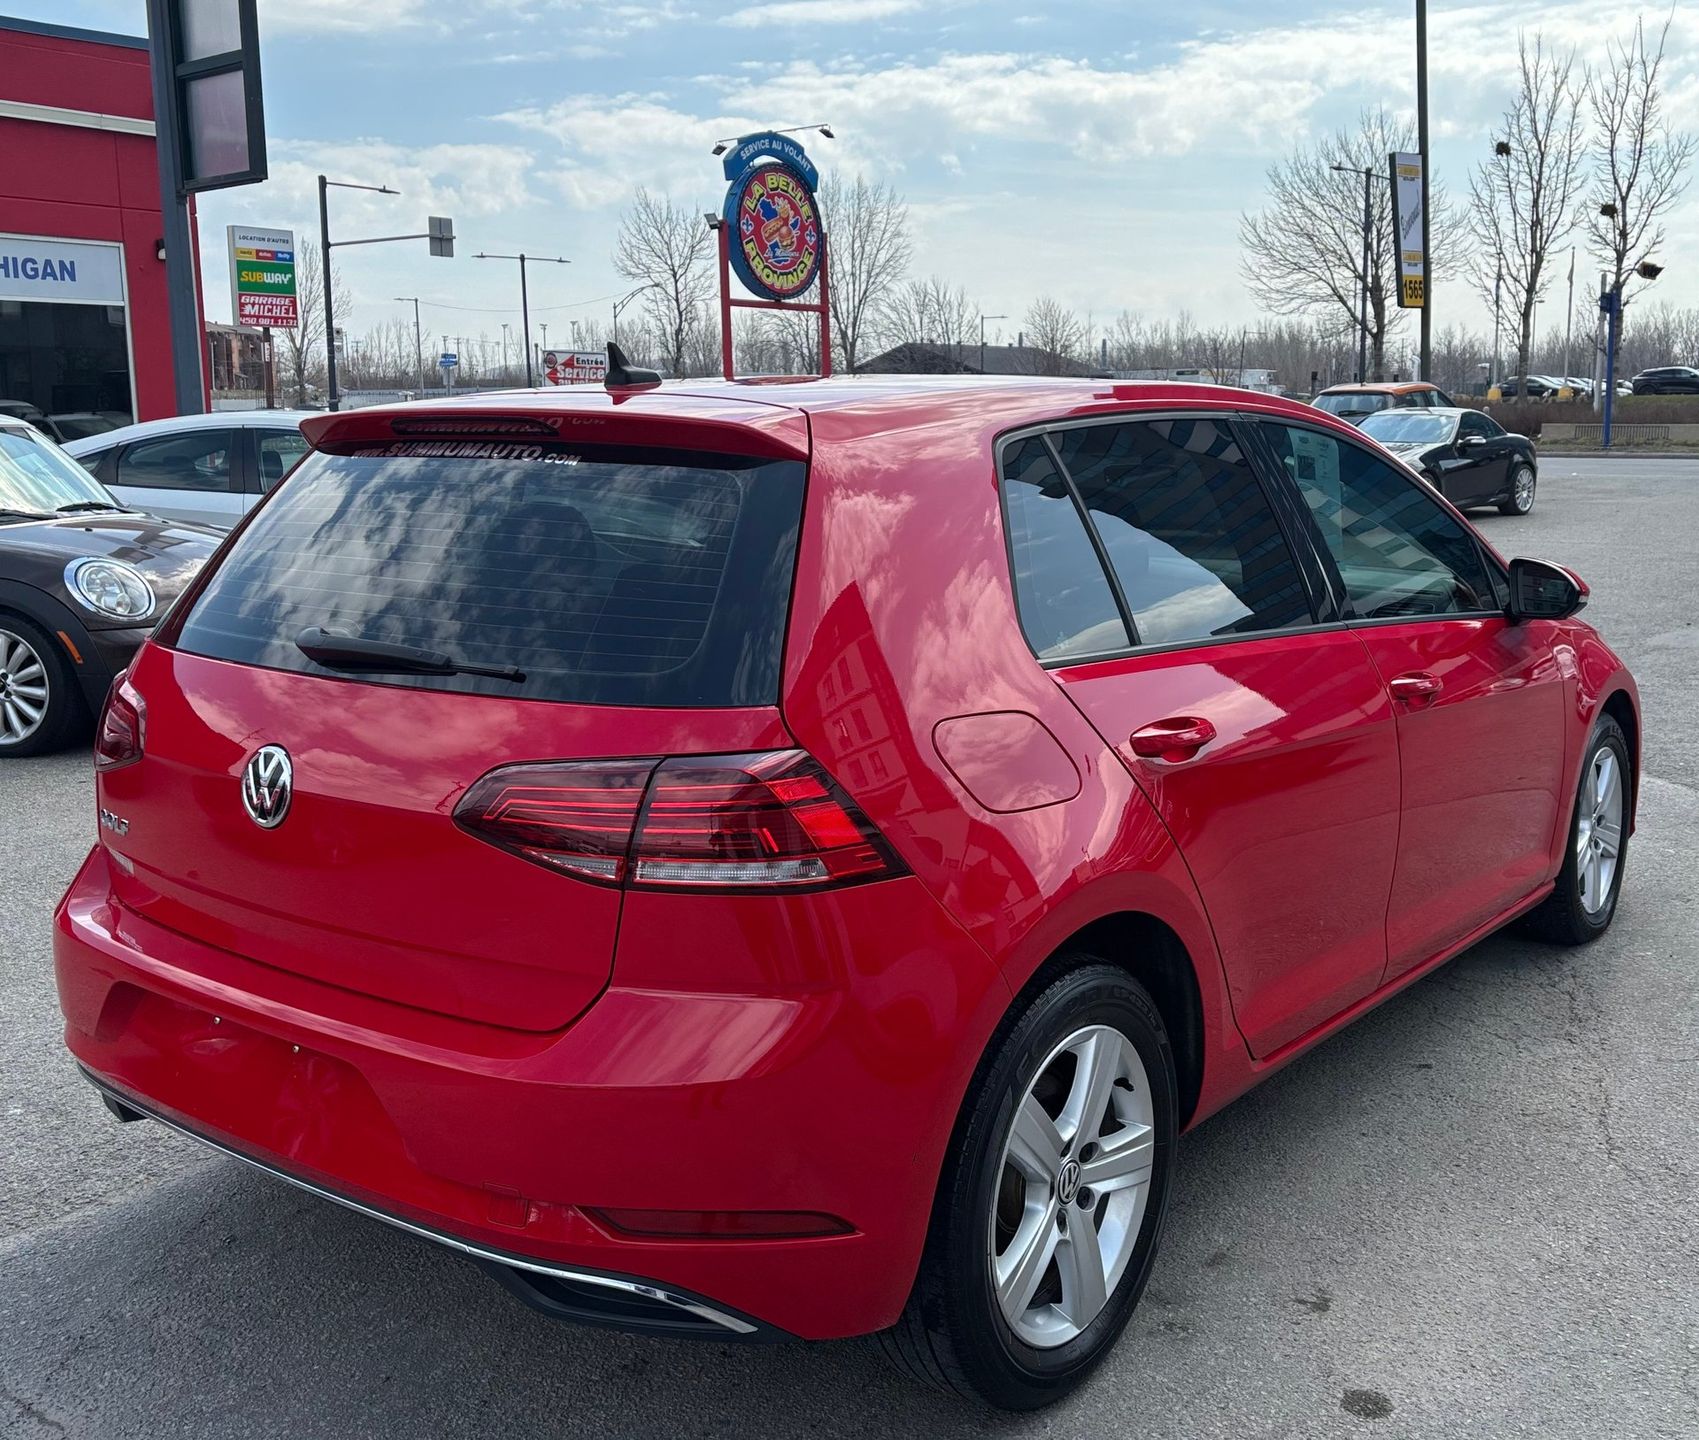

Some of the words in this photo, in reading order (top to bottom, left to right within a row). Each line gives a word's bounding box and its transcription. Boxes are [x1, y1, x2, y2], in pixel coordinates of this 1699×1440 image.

[740, 139, 770, 160] SERVICE
[772, 140, 782, 150] AU
[784, 144, 812, 171] VOLANT
[745, 181, 766, 213] LA
[765, 172, 813, 224] BELLE
[238, 234, 266, 242] LOCATION
[743, 236, 814, 290] PROVINCE
[240, 271, 292, 284] SUBWAY
[1404, 279, 1423, 299] 1565
[241, 295, 295, 306] GARAGE
[244, 303, 296, 317] MICHEL
[576, 357, 604, 366] Entrée
[556, 365, 605, 379] Service
